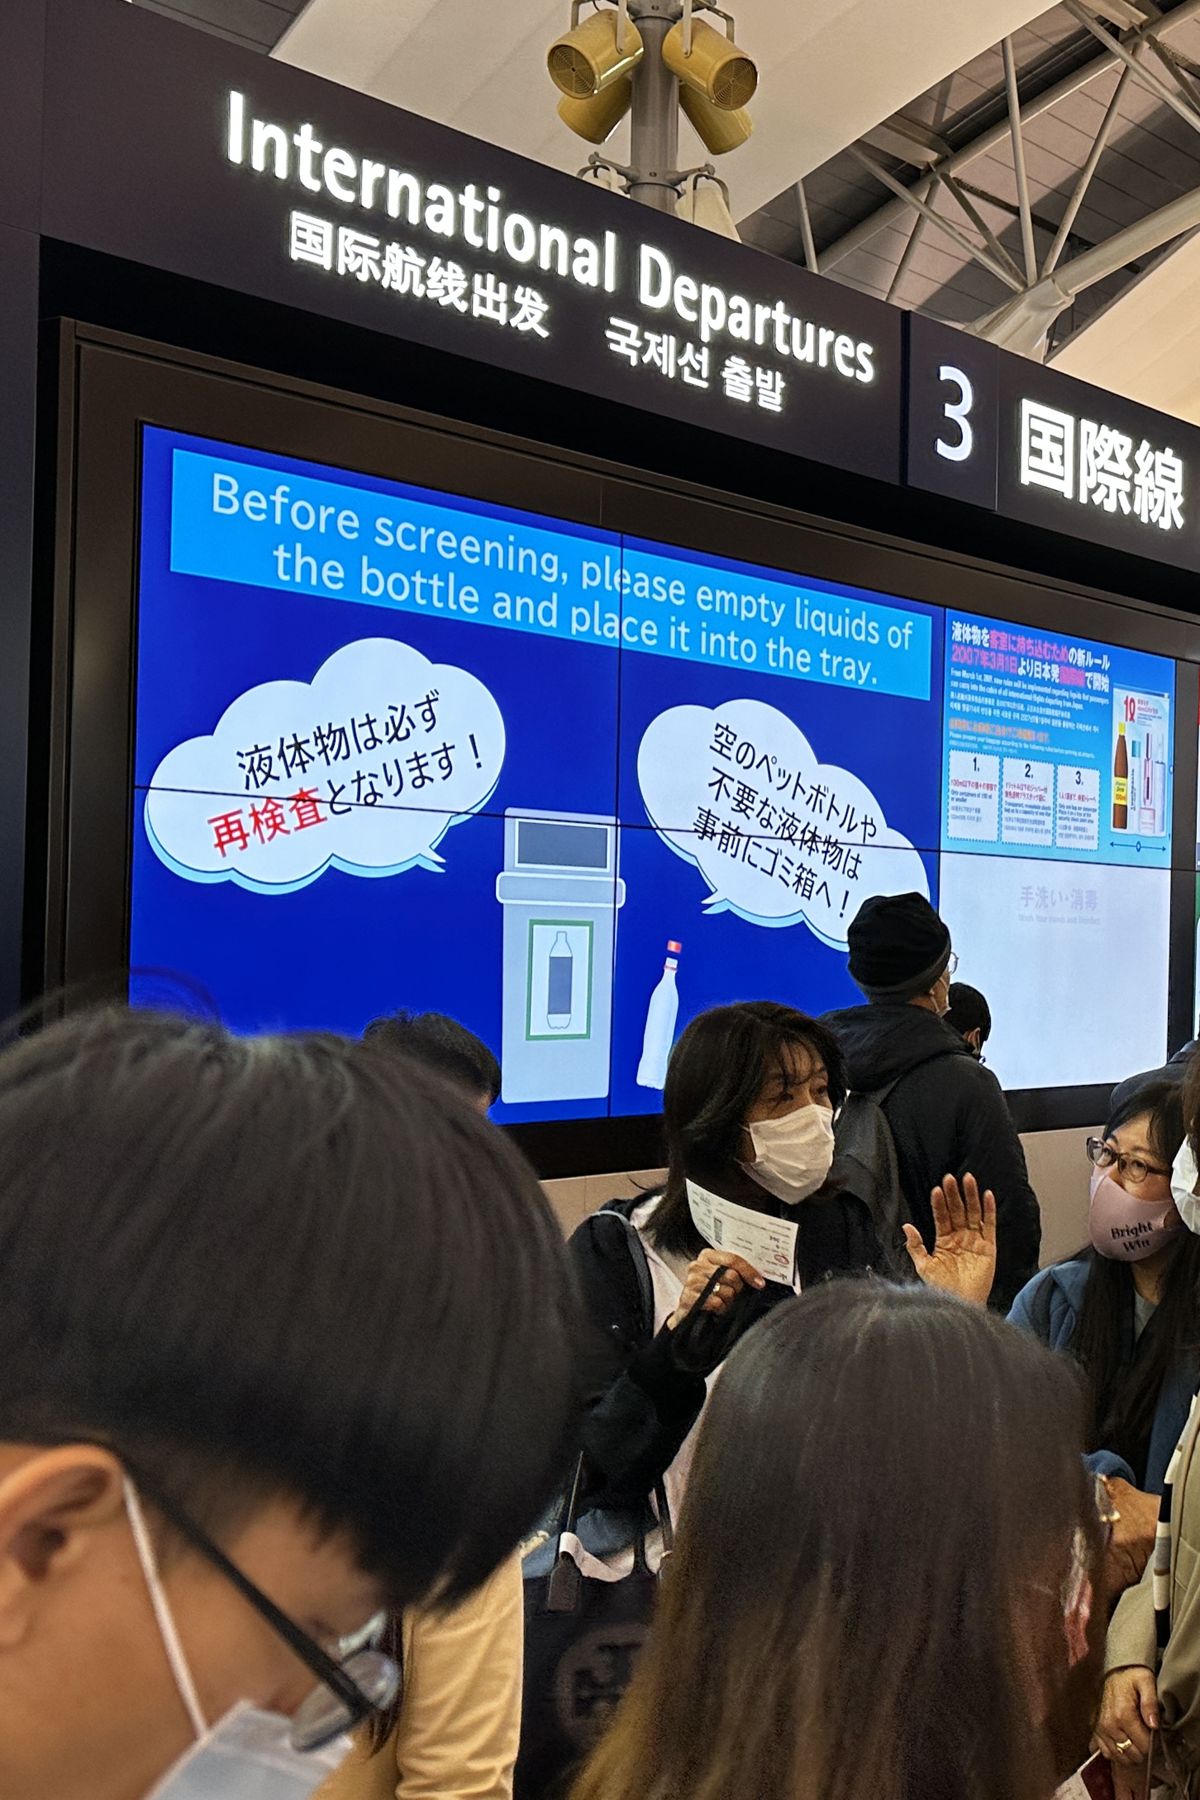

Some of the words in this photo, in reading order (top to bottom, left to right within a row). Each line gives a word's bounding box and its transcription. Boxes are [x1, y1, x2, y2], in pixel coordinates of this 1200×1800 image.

[227, 90, 615, 294] International
[639, 243, 876, 384] Departures
[288, 210, 550, 338] 国际航线出发
[605, 316, 710, 388] 국제선
[720, 356, 788, 413] 출발
[935, 365, 974, 461] 3
[1020, 397, 1185, 531] 国際線
[212, 472, 360, 540] Before
[374, 514, 568, 585] screening,
[582, 555, 685, 605] please
[696, 584, 785, 627] empty
[795, 596, 880, 645] liquids
[887, 620, 913, 650] of
[273, 542, 345, 591] the
[361, 555, 479, 614] bottle
[492, 592, 557, 628] and
[571, 600, 658, 646] place
[669, 615, 690, 652] it
[701, 622, 757, 663] into
[766, 636, 811, 673] the
[820, 648, 877, 685] tray.
[208, 733, 483, 858] 再検査となります！
[236, 688, 440, 790] 液体物は必ず
[709, 722, 877, 844] 空のペットボトルや
[693, 806, 850, 919] 事前にゴミ箱へ！
[708, 766, 862, 881] 不要な液体物は
[1111, 1221, 1154, 1240] Bright
